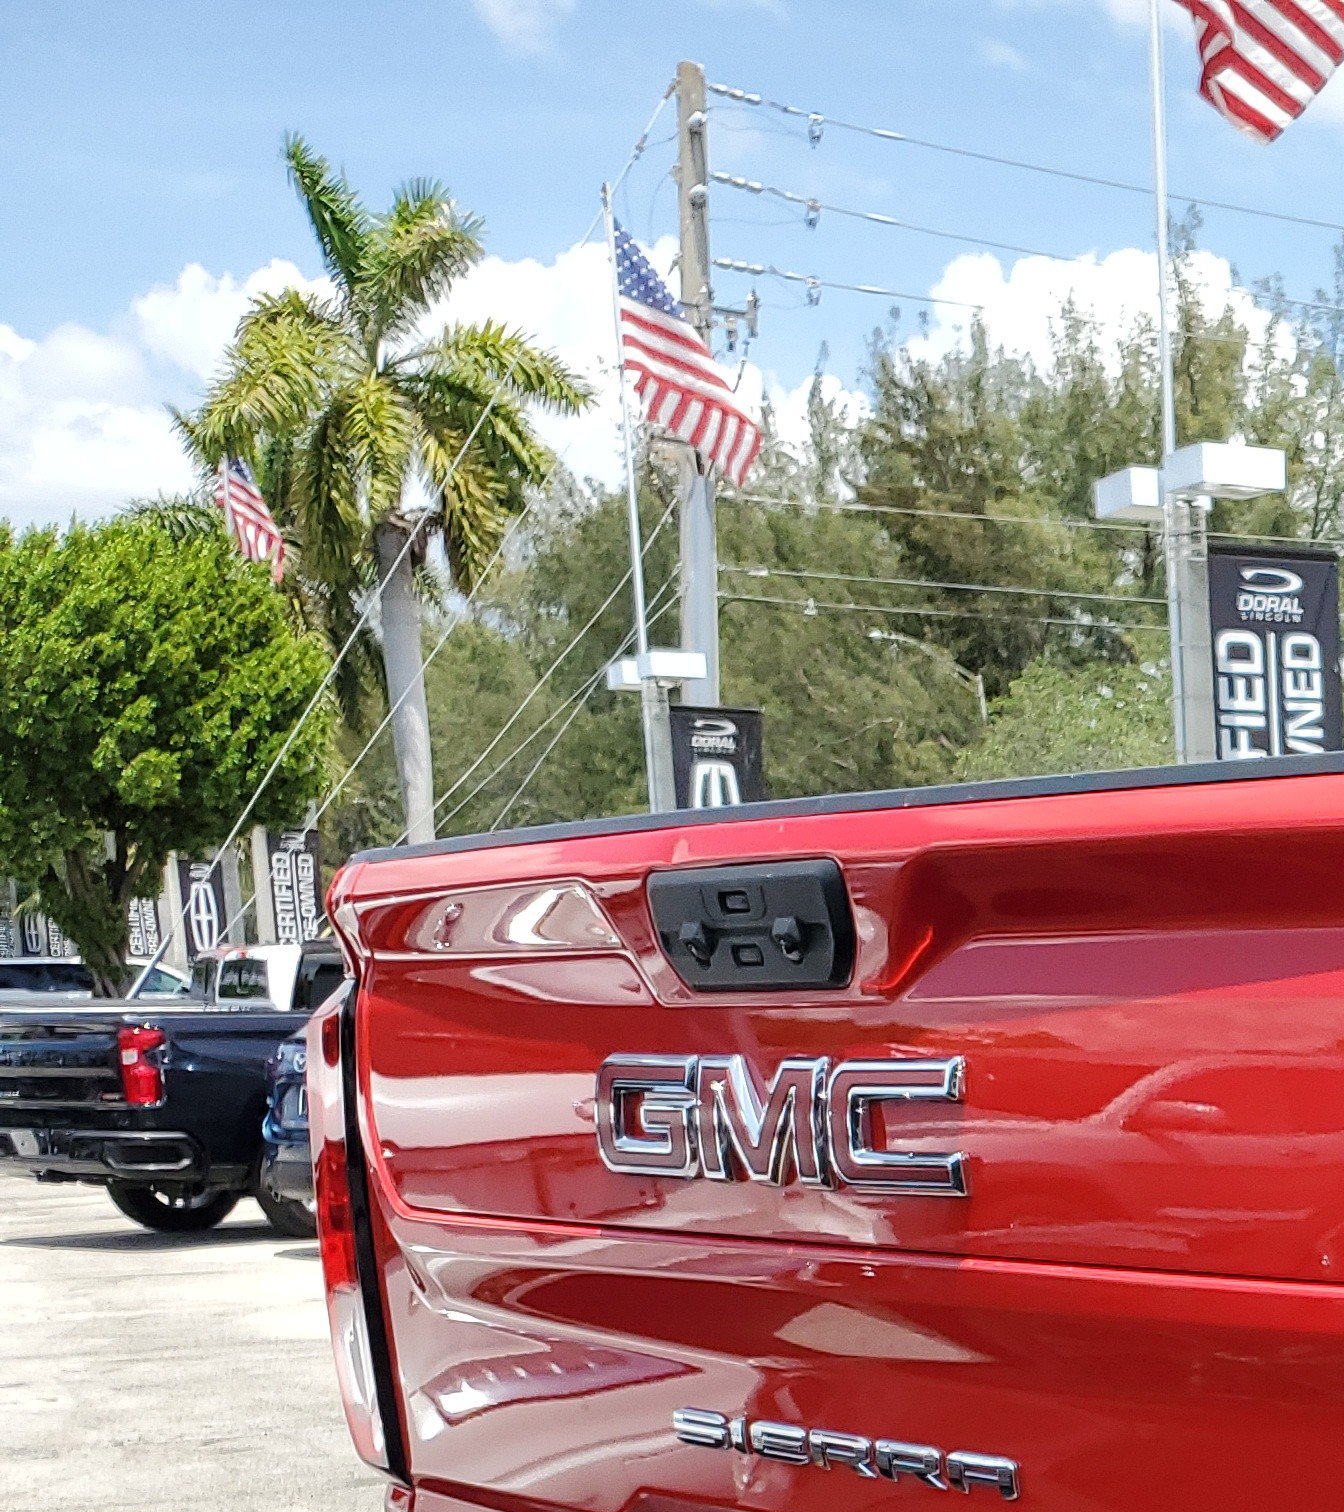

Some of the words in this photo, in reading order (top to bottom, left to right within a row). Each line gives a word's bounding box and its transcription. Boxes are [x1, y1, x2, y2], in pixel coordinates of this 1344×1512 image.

[1237, 593, 1304, 615] DORAL
[595, 1052, 971, 1198] GMC
[672, 1405, 1022, 1502] SIERRA
